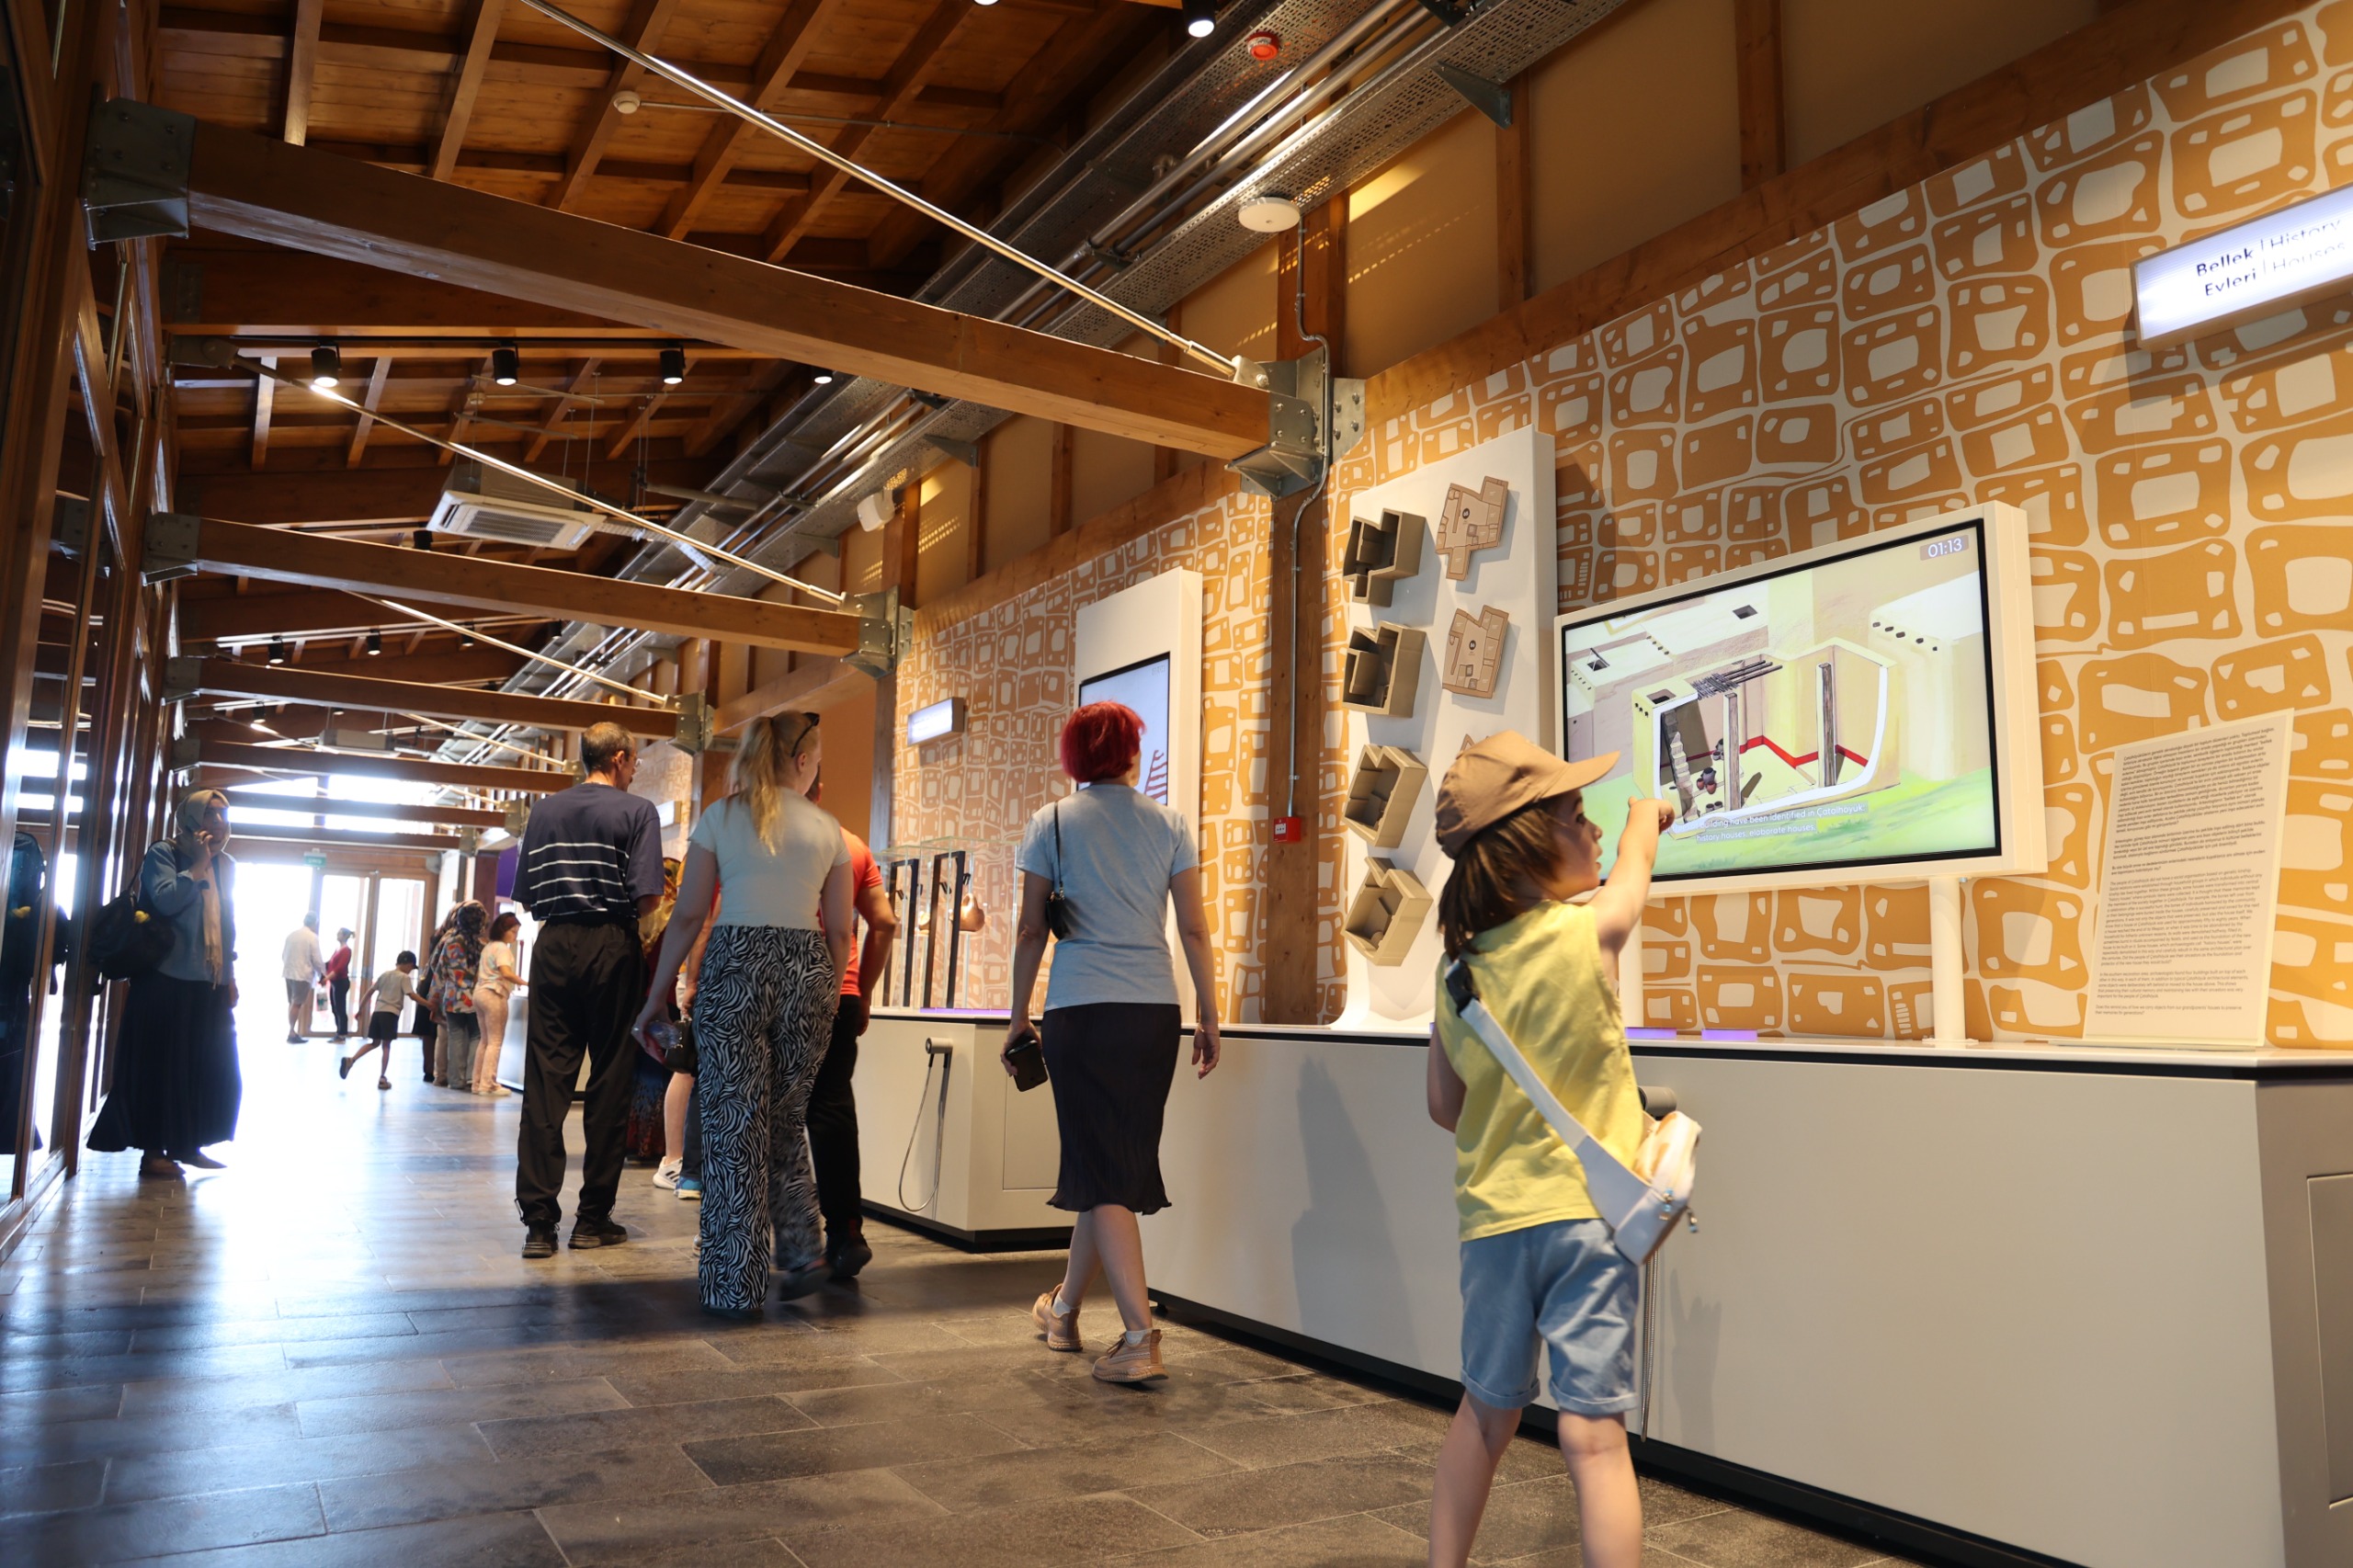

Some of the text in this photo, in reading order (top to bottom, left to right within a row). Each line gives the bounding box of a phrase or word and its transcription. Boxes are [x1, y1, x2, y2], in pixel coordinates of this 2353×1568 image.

[2196, 219, 2341, 277] Bellek History
[2204, 267, 2256, 296] Evleri
[1927, 537, 1962, 558] 01:13
[1731, 815, 1748, 825] have
[1749, 813, 1768, 824] been
[1769, 810, 1806, 822] identified
[1697, 833, 1720, 842] history
[1749, 826, 1786, 836] elaborate
